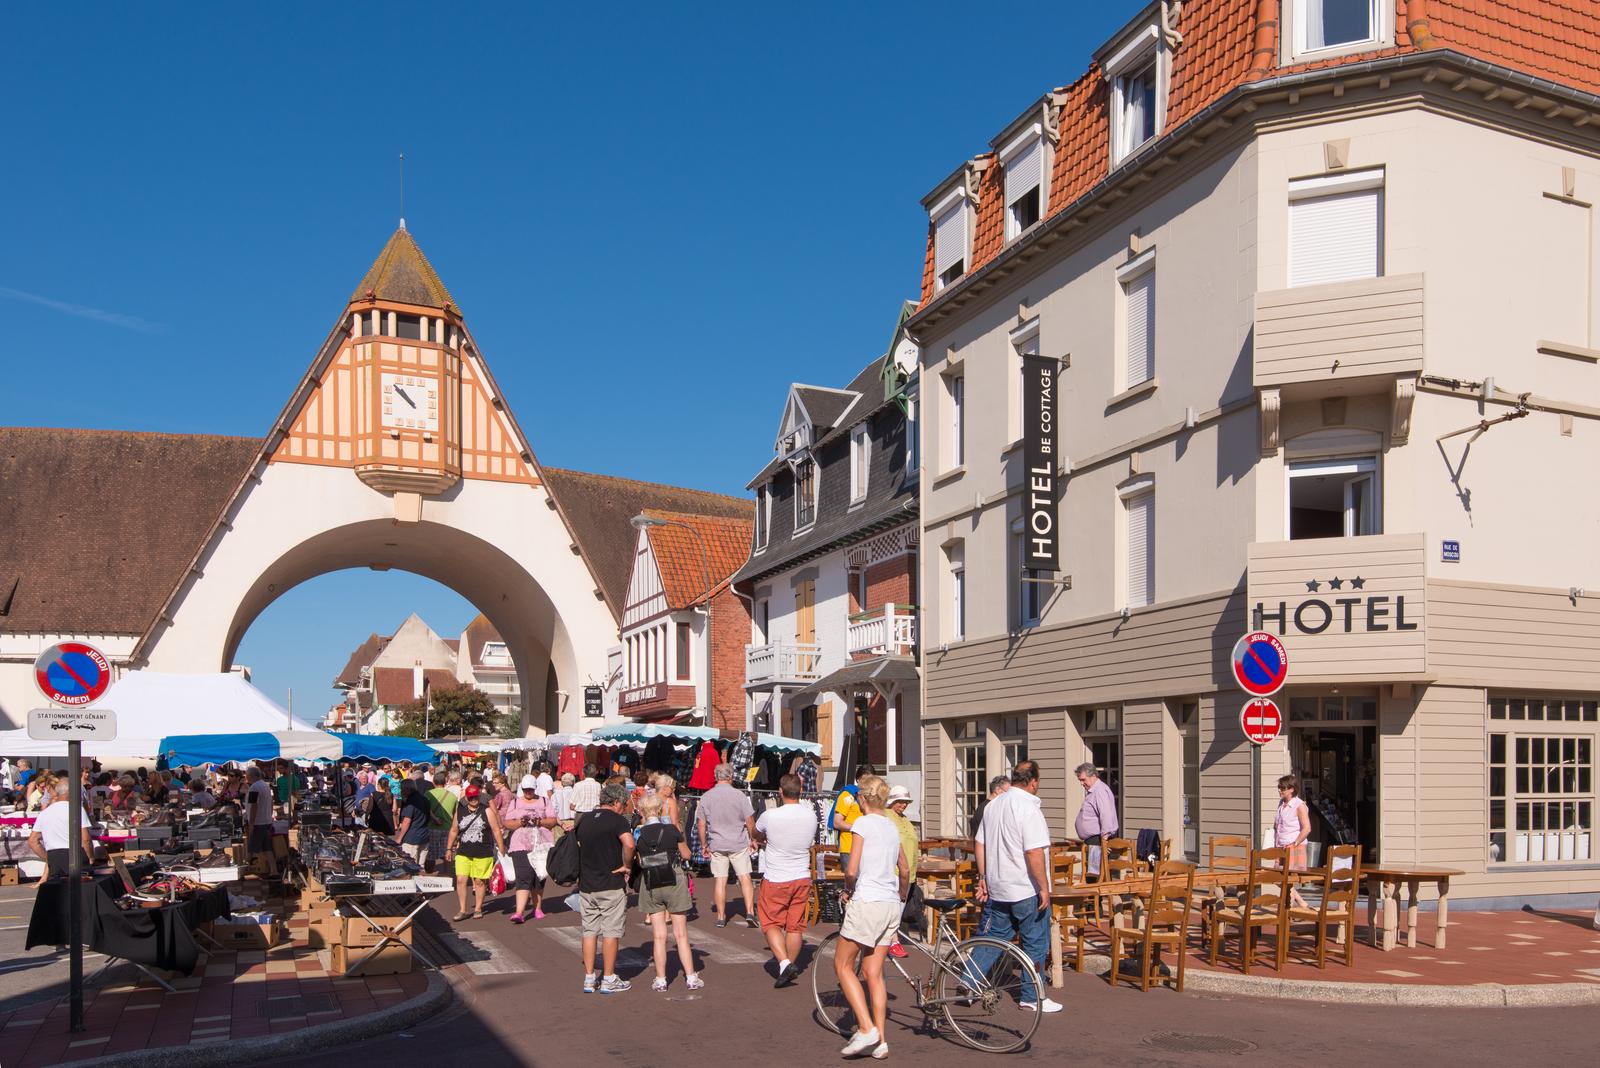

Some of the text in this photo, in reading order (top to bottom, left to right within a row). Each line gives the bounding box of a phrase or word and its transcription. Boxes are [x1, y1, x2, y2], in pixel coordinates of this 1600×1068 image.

[1031, 368, 1052, 559] HOTEL BE COTTAGE
[1256, 595, 1418, 635] HOTEL
[85, 650, 109, 672] JEUDI
[1270, 639, 1286, 665] SAMEDI
[53, 693, 90, 704] SAMEDI
